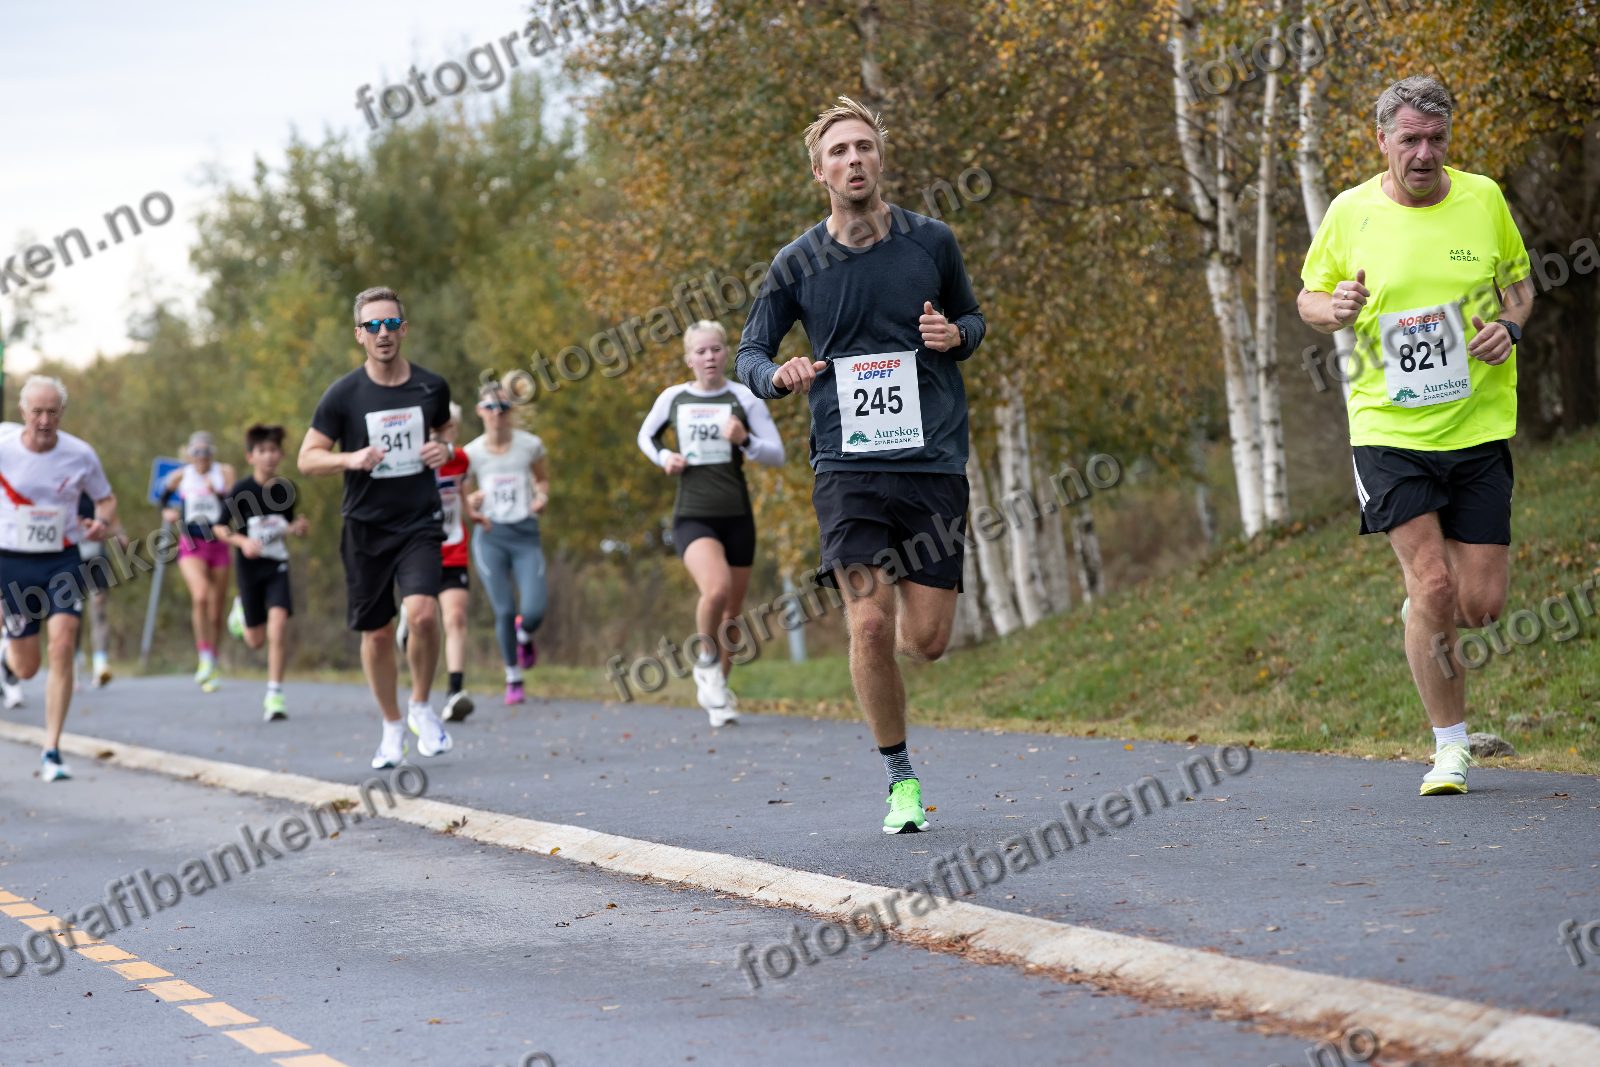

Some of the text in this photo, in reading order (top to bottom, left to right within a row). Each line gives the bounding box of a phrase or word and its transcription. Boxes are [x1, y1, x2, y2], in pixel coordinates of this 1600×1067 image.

[1397, 311, 1446, 328] NORGES
[1403, 322, 1440, 336] LØPET
[1400, 338, 1447, 373] 821
[852, 359, 901, 373] NORGES
[857, 368, 893, 381] LØPET
[1423, 378, 1468, 394] Aurskog
[853, 385, 904, 417] 245
[689, 423, 720, 441] 792
[874, 426, 920, 438] Aurskog
[381, 430, 411, 453] 341
[27, 524, 57, 543] 760
